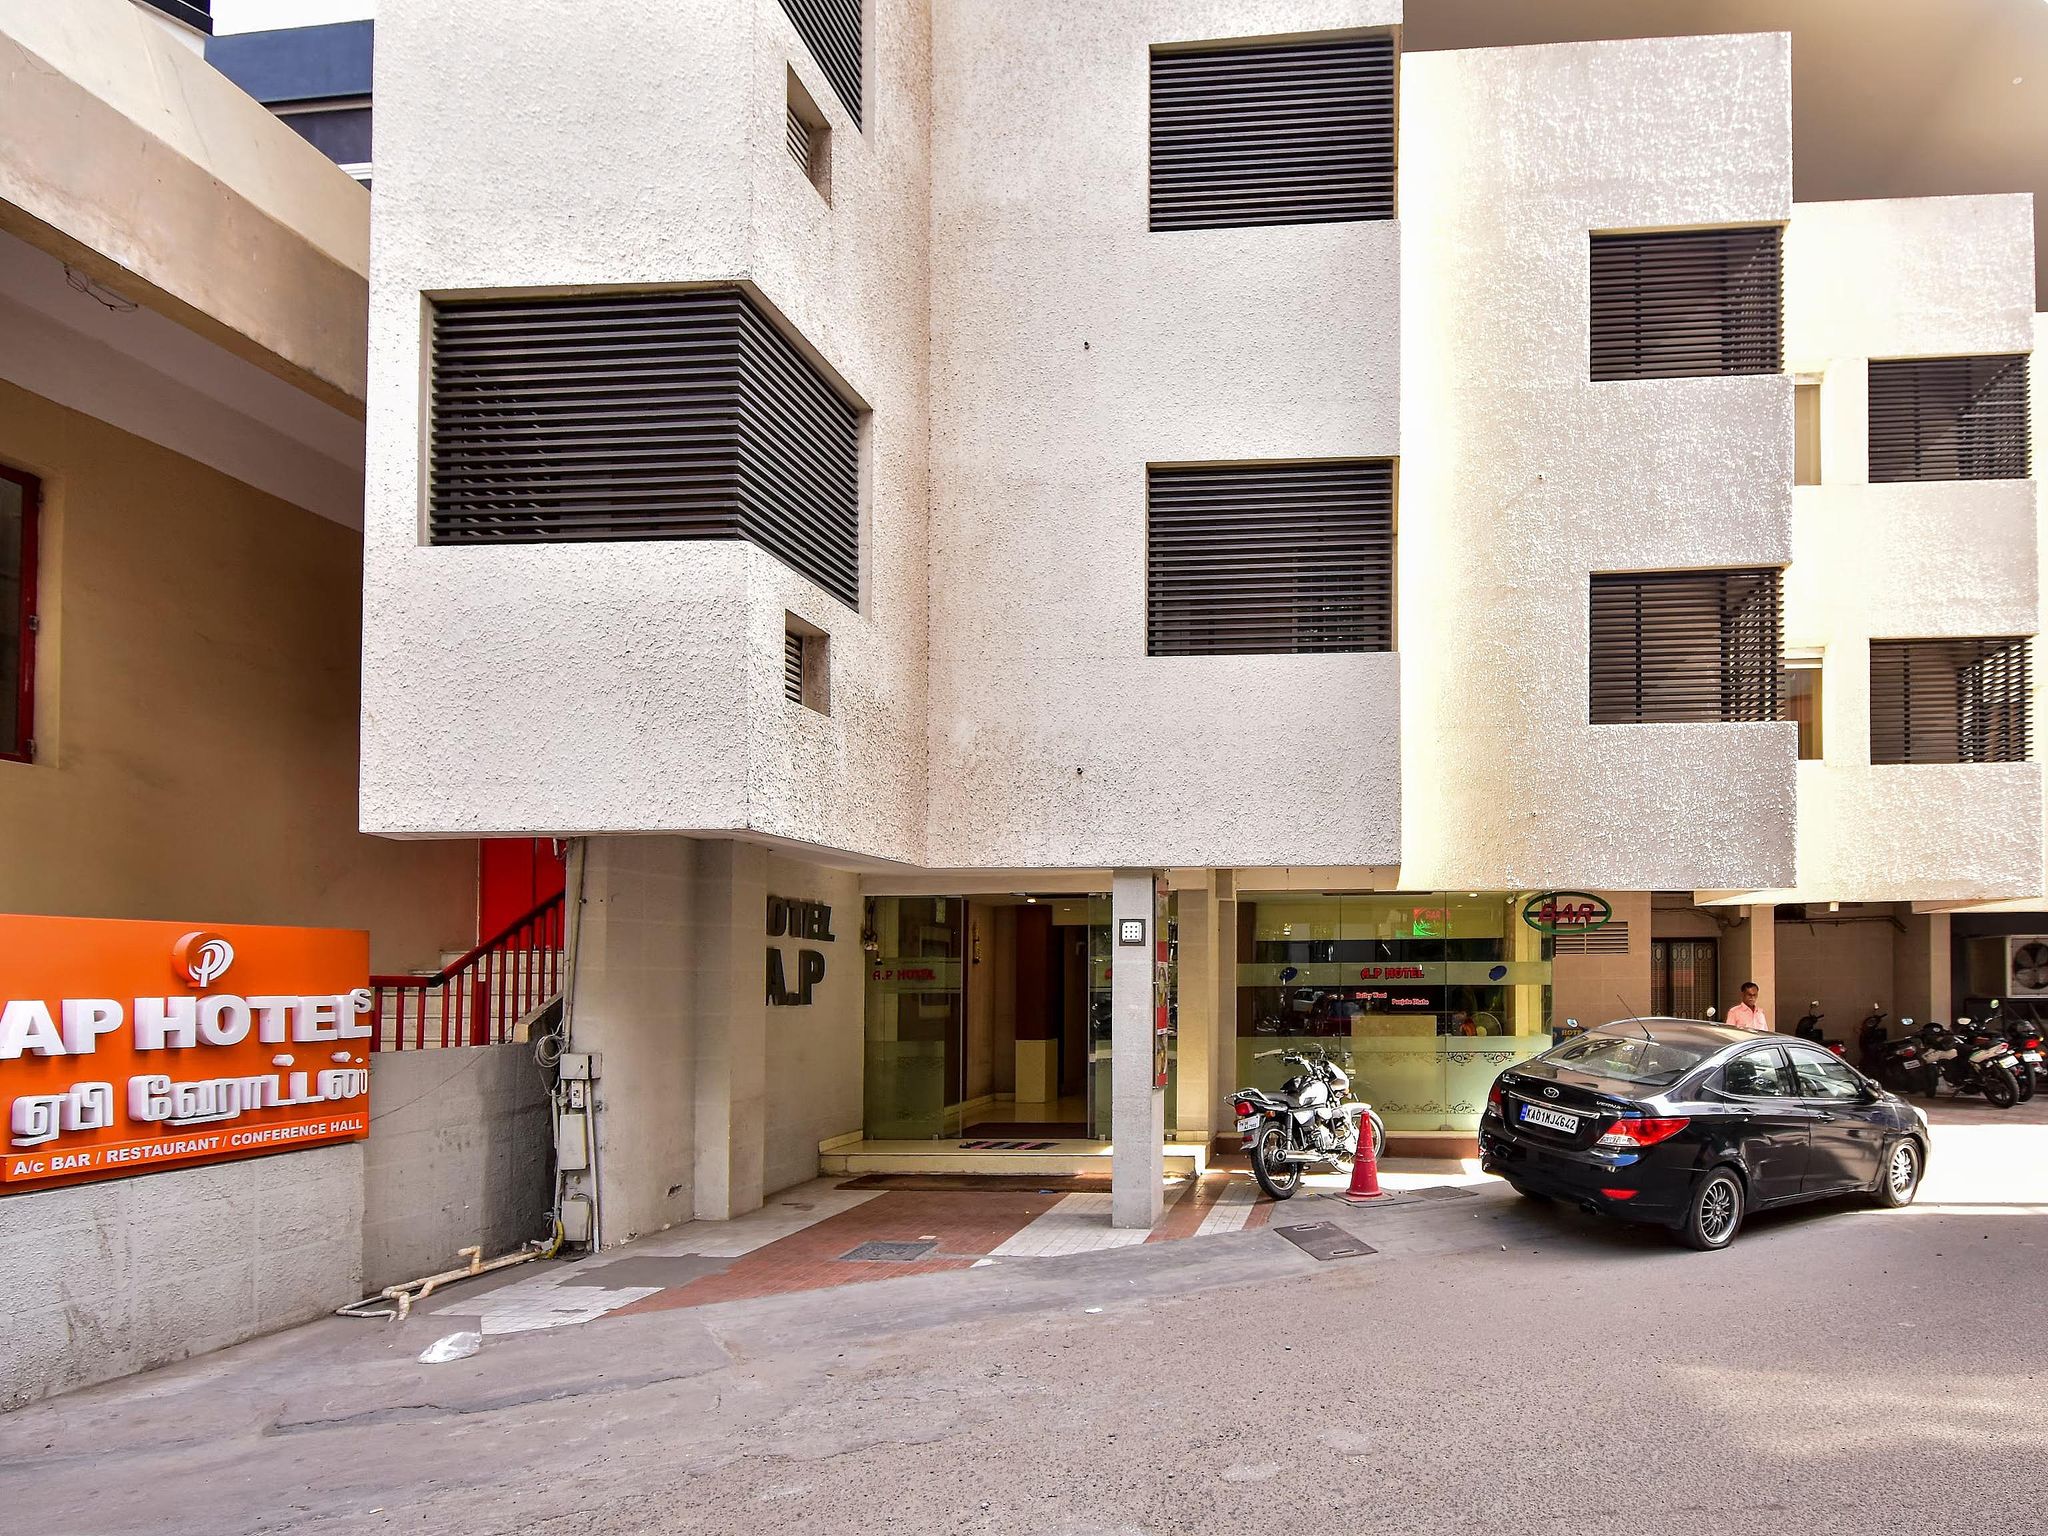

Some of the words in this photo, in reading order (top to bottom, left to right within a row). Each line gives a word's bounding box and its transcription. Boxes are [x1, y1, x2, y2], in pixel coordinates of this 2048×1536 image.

[766, 896, 836, 942] OTEL
[1538, 903, 1595, 924] BAR
[897, 967, 937, 981] HOTEL
[1384, 965, 1425, 980] HOTEL
[0, 999, 124, 1060] AP
[1526, 1107, 1577, 1131] KA01MJ4642
[51, 1152, 91, 1171] BAR
[106, 1136, 220, 1164] RESTAURANT
[231, 1123, 327, 1147] CONFERENCE
[330, 1118, 363, 1133] HALL
